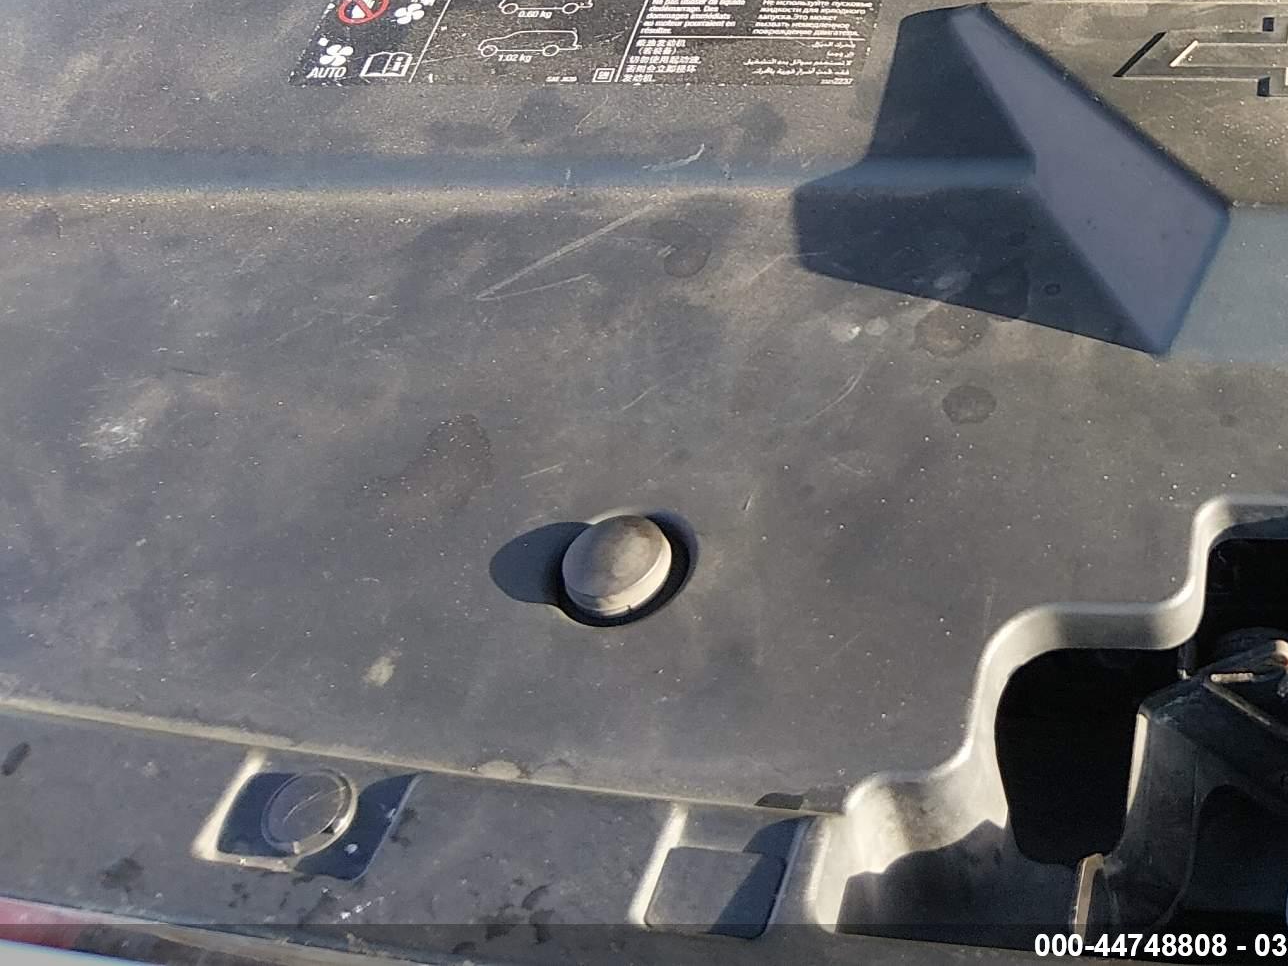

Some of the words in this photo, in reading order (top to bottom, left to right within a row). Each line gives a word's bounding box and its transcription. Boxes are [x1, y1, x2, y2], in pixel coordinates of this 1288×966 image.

[539, 11, 553, 19] kg
[497, 54, 518, 62] 1.02
[518, 54, 533, 63] kg
[306, 66, 347, 79] AUTO
